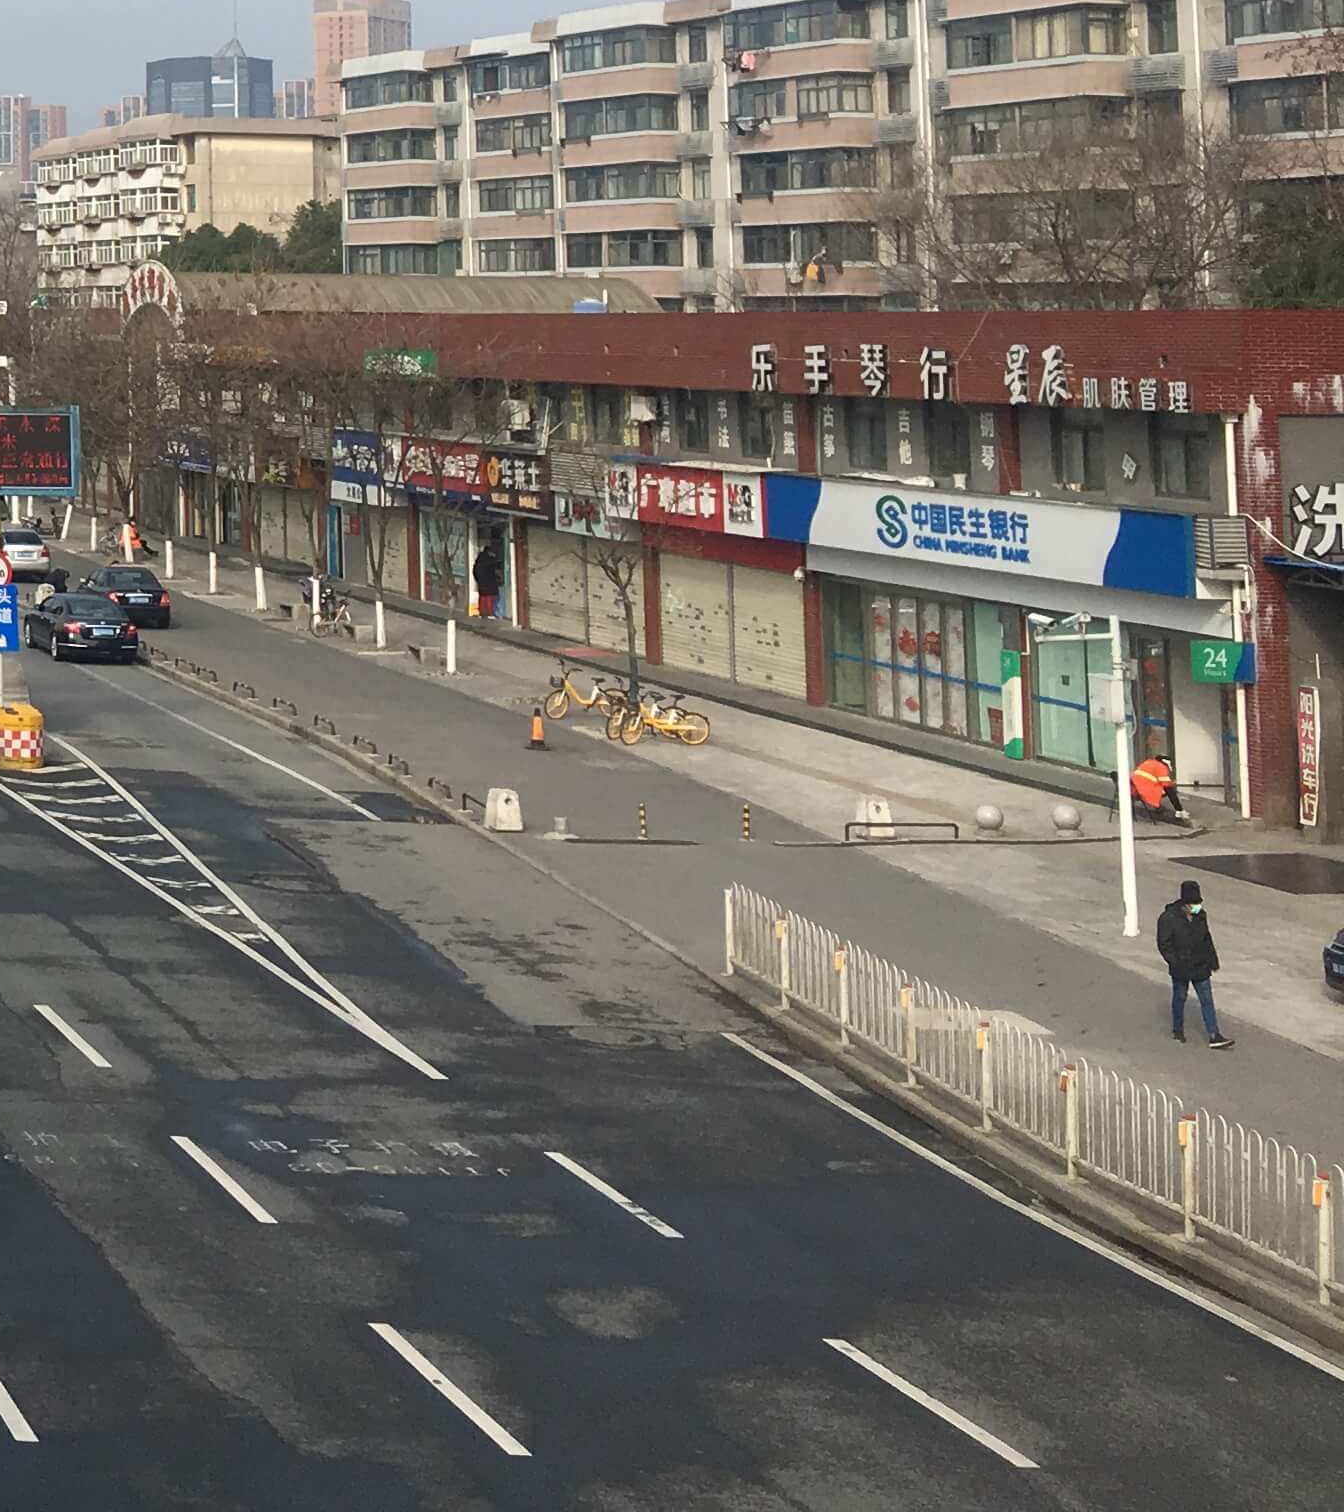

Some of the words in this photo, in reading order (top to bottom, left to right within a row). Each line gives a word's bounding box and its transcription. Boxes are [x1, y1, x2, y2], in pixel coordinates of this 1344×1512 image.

[751, 344, 951, 400] 乐手琴行
[1004, 344, 1072, 406] 星辰
[1082, 377, 1190, 414] 肌肤管理
[898, 407, 912, 465] 吉他
[980, 412, 995, 471] 钢琴
[911, 502, 1029, 544] 中国民生银行
[1293, 483, 1344, 556] 洗
[913, 535, 944, 552] CHINA
[945, 539, 997, 559] MINSHENG
[1002, 546, 1031, 564] BANK
[1203, 647, 1228, 668] 24
[1300, 691, 1317, 816] 阳光洗车行
